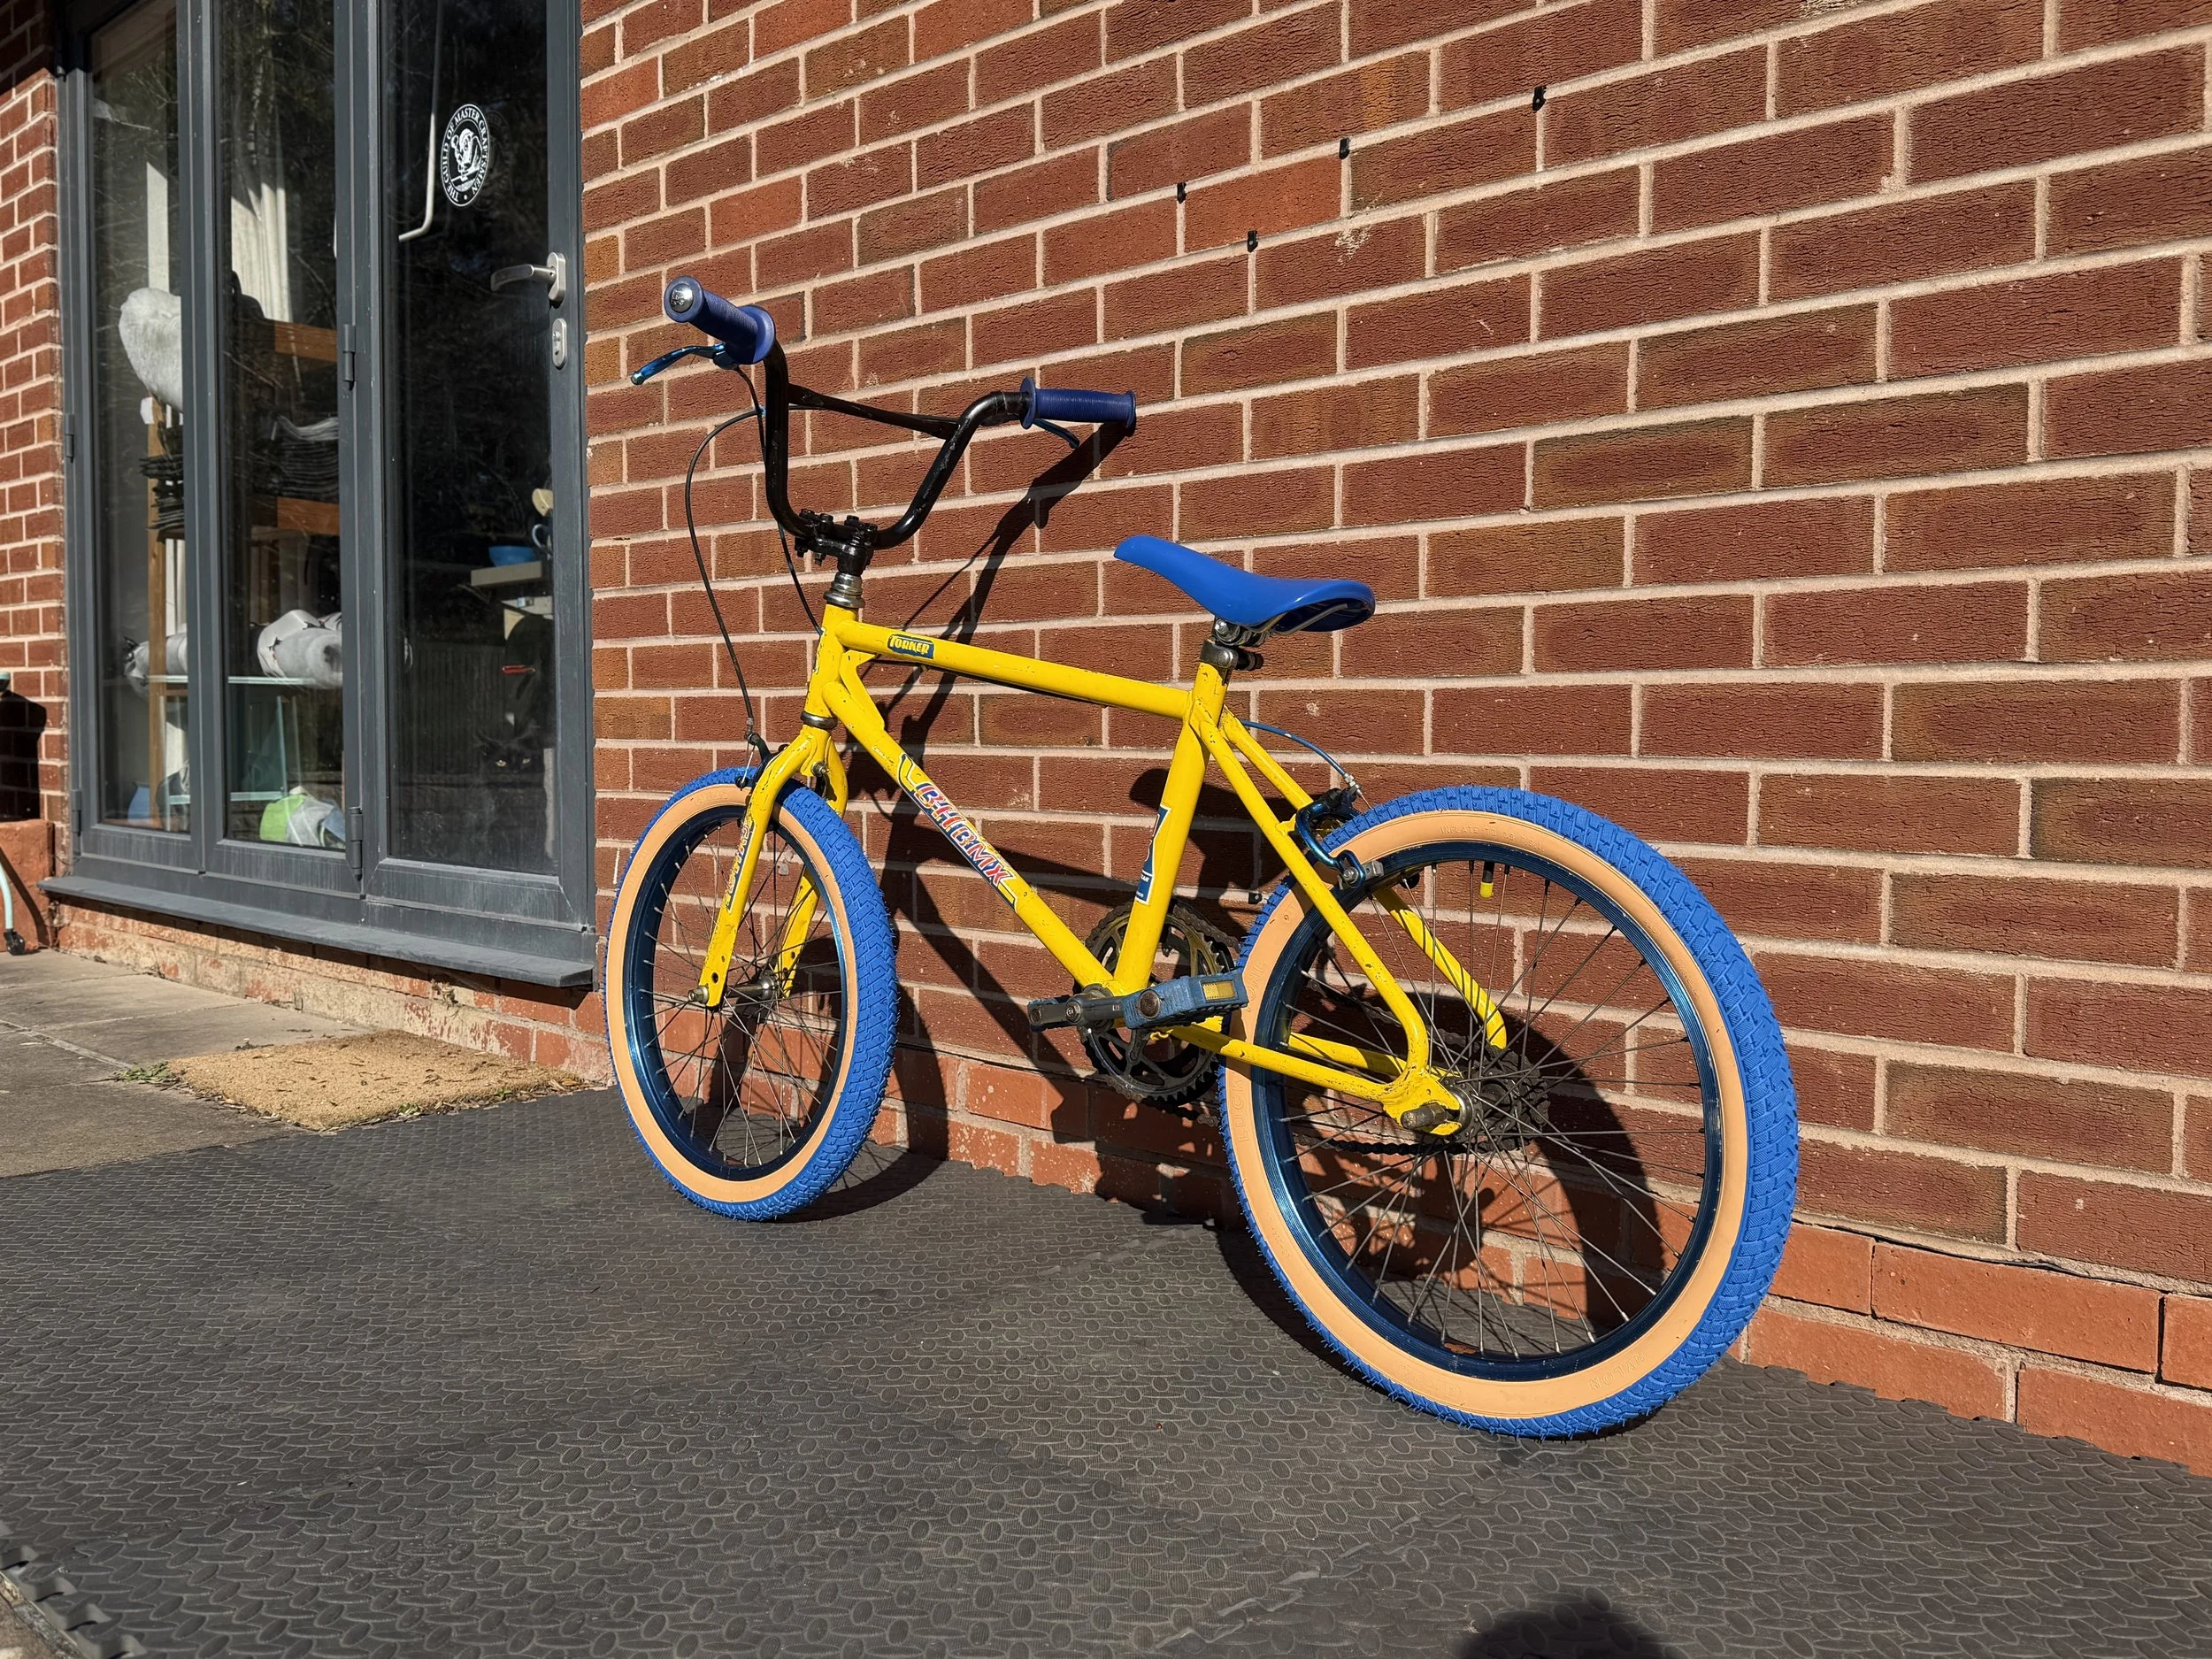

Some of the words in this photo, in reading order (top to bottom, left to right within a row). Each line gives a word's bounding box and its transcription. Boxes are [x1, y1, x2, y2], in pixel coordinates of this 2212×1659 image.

[454, 107, 480, 126] MASTER
[446, 123, 455, 140] OF
[472, 119, 488, 195] CRAFTSMEN
[446, 182, 459, 203] THE
[1589, 1351, 1647, 1390] NYLON
